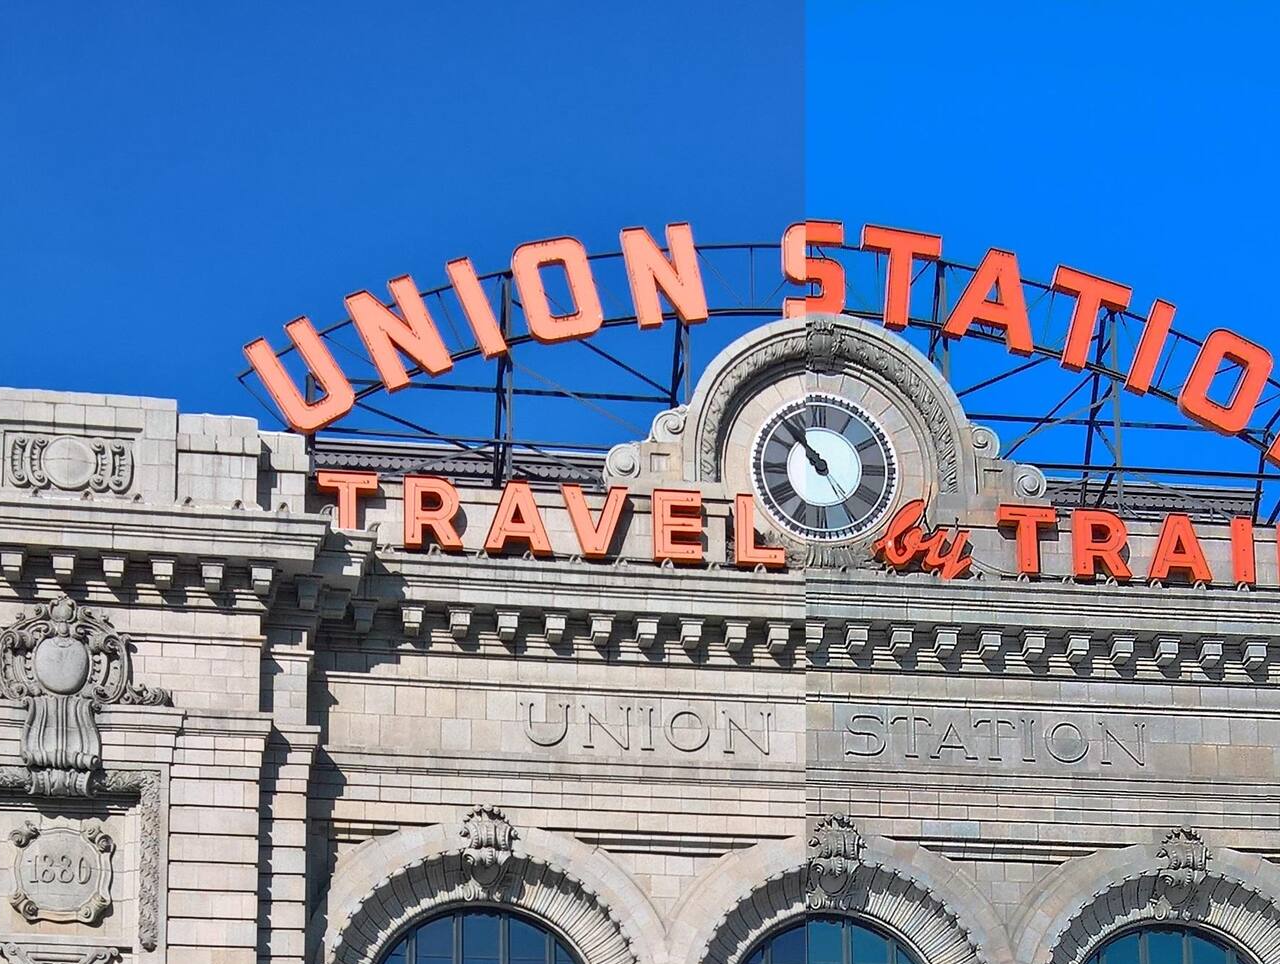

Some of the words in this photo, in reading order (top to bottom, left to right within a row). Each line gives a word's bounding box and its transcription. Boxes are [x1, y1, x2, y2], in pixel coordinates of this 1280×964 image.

[242, 221, 709, 436] UNION
[317, 470, 786, 569] TRAVEL
[872, 499, 974, 579] by
[520, 702, 771, 756] UNION
[845, 714, 1145, 767] STATION
[28, 855, 93, 885] 1880
